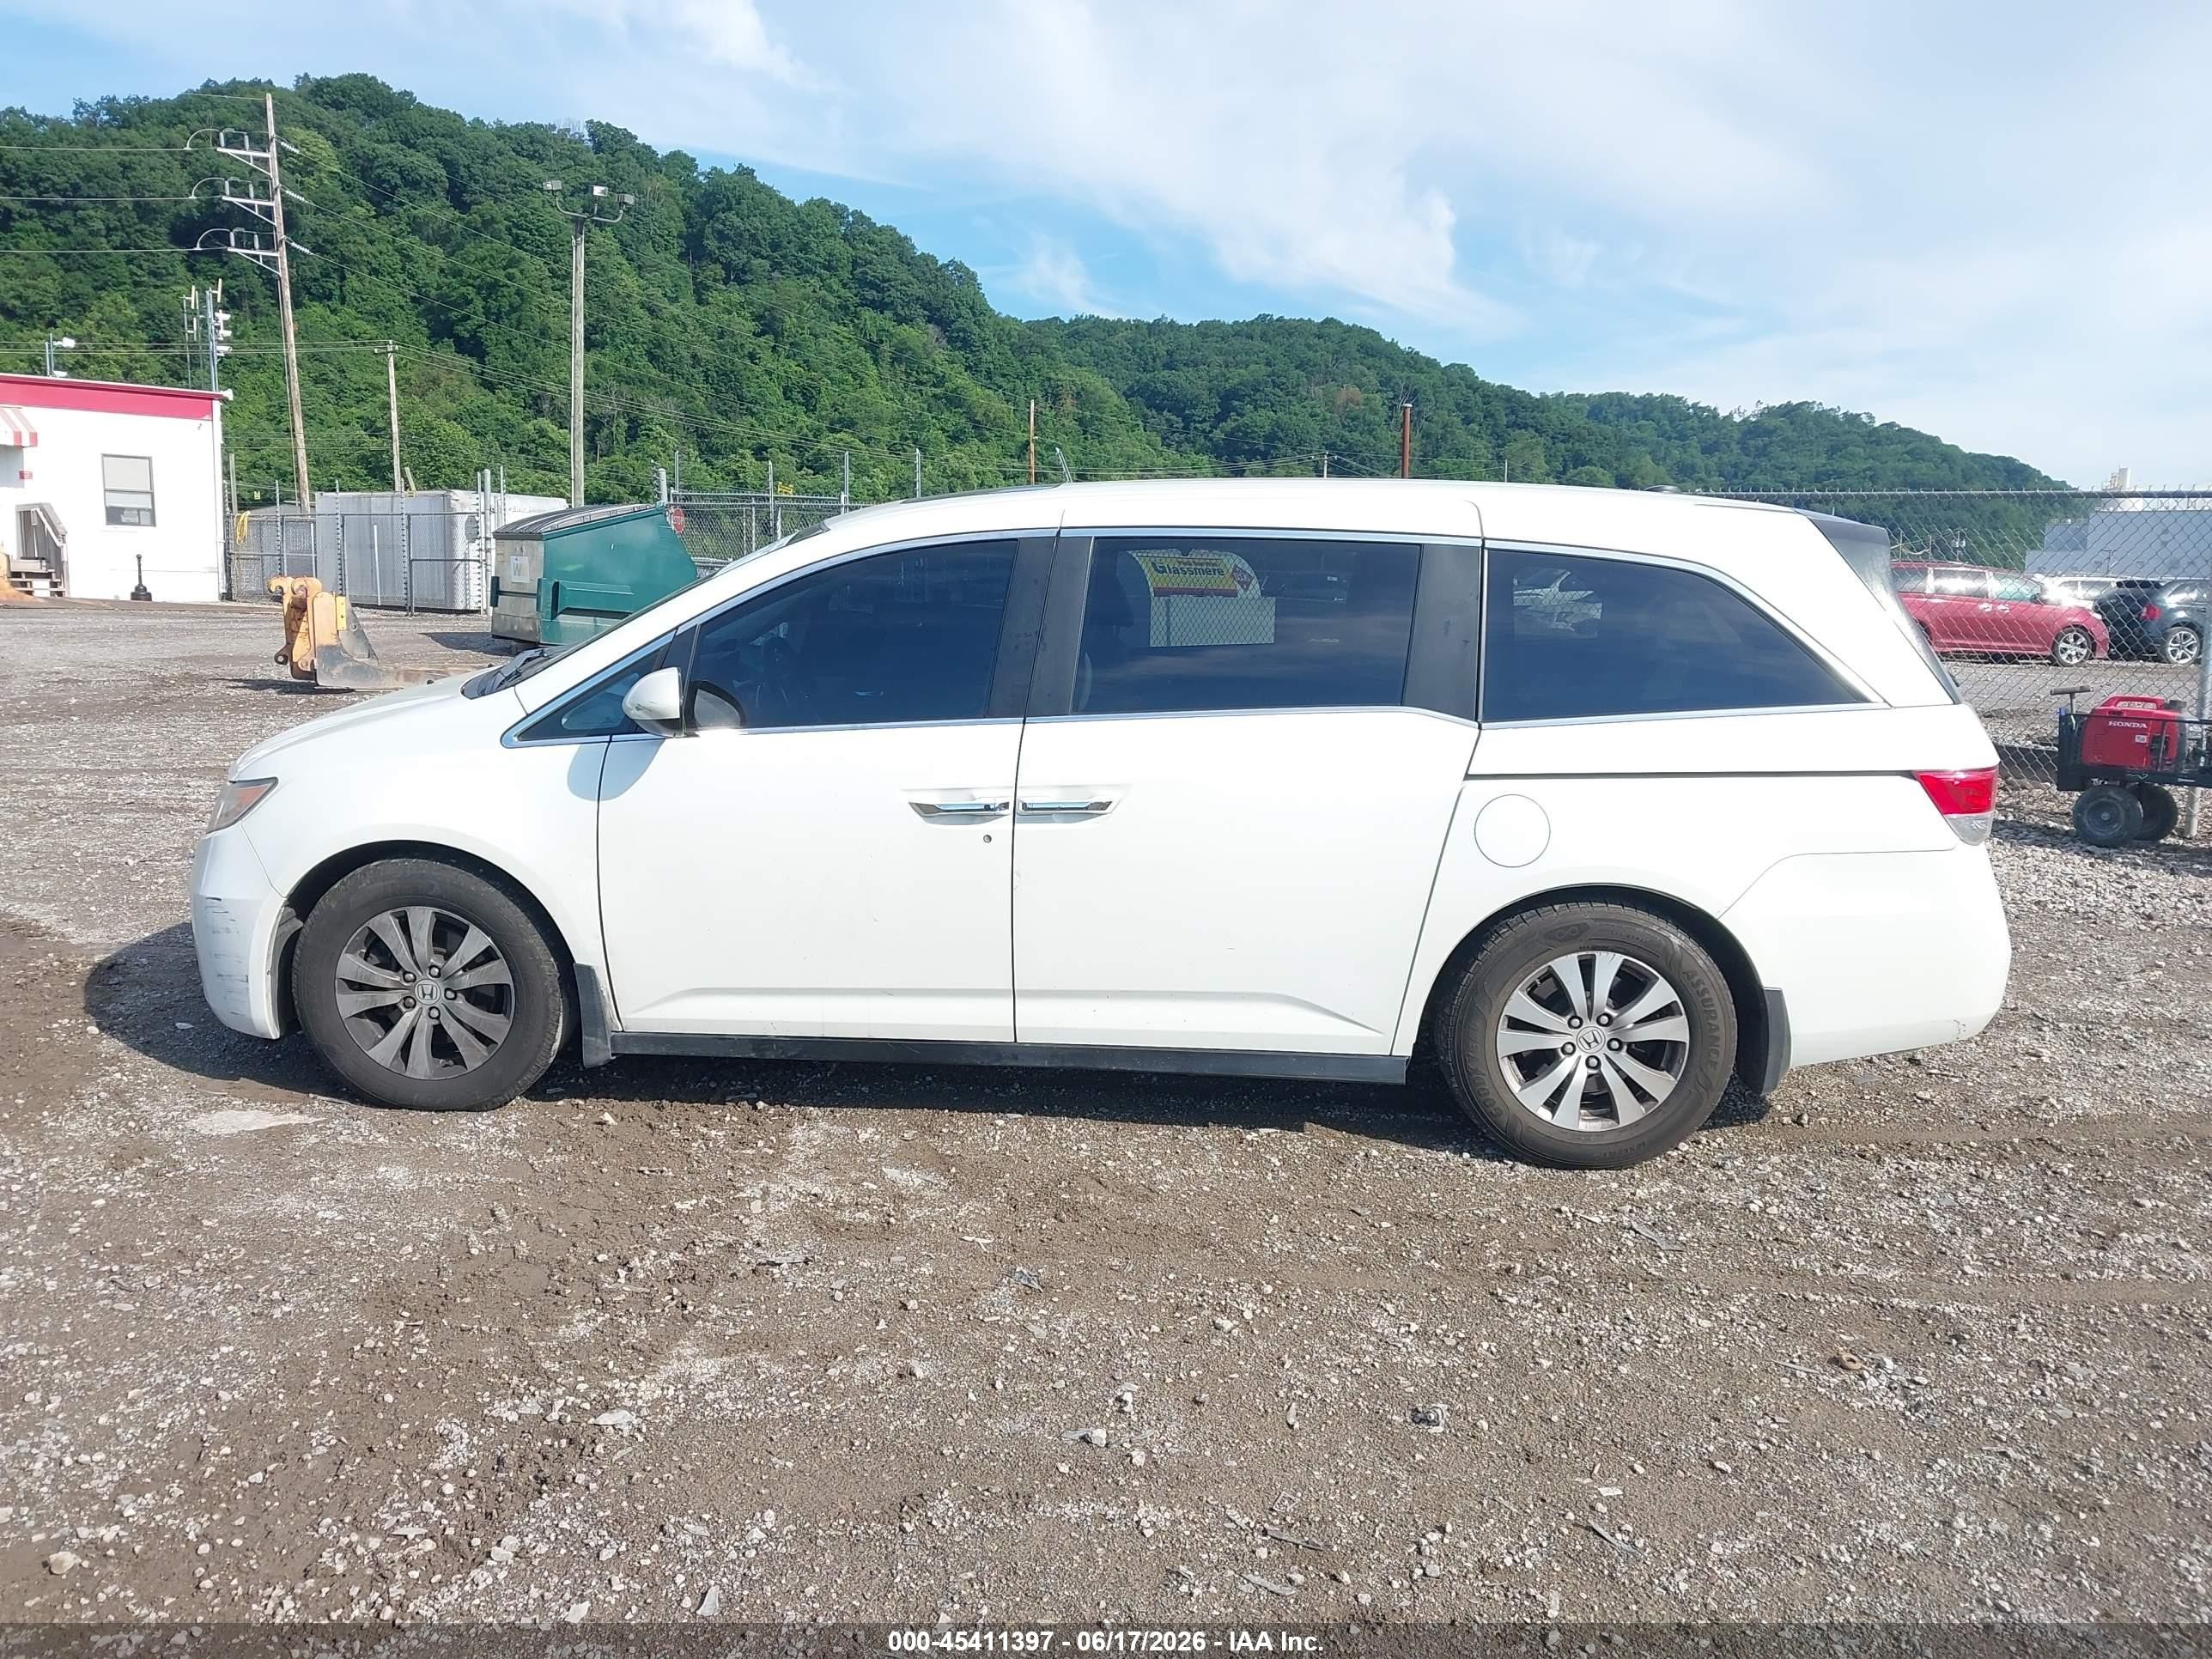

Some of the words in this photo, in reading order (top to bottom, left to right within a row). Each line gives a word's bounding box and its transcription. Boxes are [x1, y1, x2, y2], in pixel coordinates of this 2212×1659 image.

[1151, 562, 1224, 577] Glassmere
[2108, 720, 2148, 729] HONDA
[1682, 970, 1720, 1071] ASSURANCE
